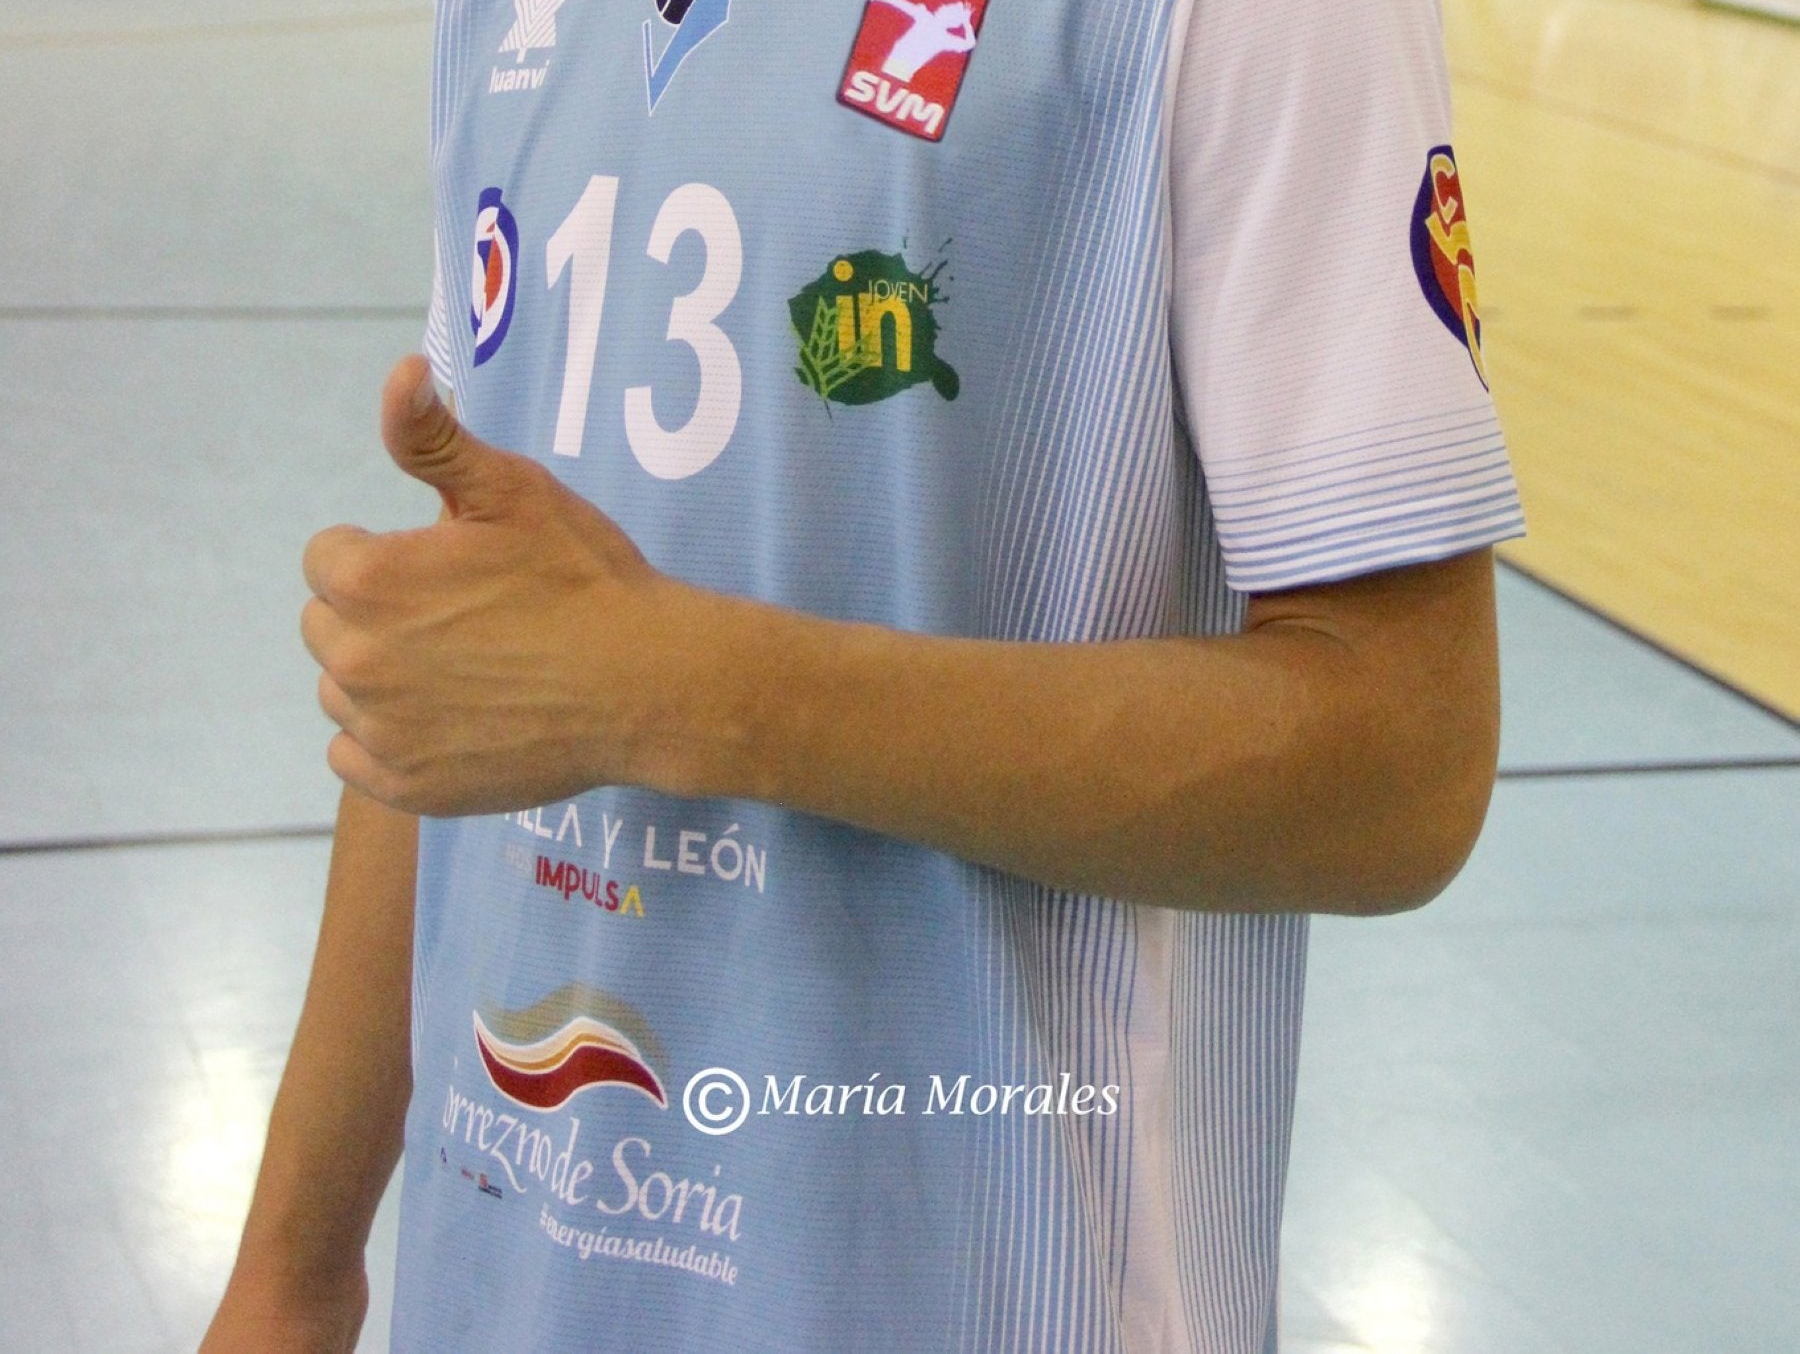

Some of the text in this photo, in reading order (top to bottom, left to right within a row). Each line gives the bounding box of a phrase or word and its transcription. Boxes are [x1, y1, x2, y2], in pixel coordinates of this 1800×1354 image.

[489, 59, 550, 94] luanvi
[843, 69, 945, 135] SVM
[867, 279, 929, 303] JOVEN
[546, 174, 743, 480] 13
[535, 854, 645, 918] IMPULSA
[602, 813, 624, 870] Y
[643, 823, 767, 894] LEÓN
[596, 1137, 744, 1242] Soria
